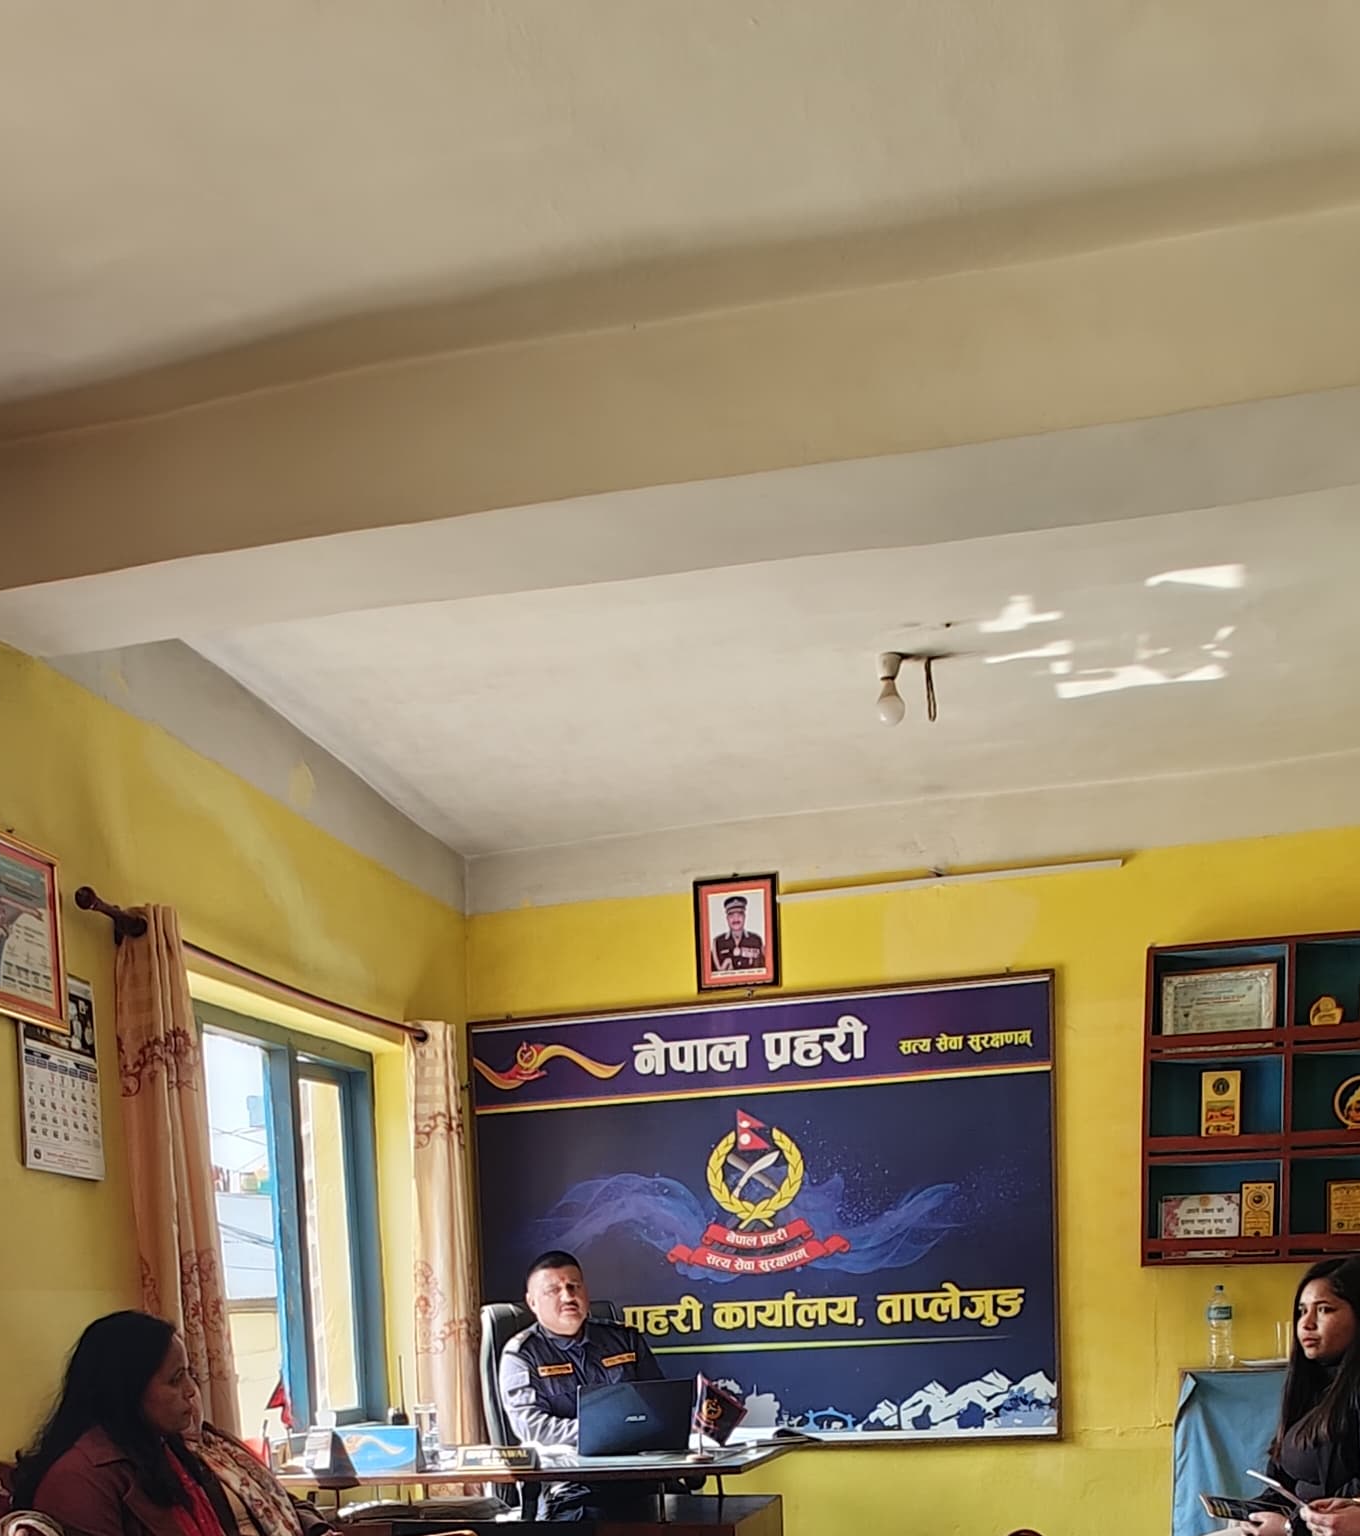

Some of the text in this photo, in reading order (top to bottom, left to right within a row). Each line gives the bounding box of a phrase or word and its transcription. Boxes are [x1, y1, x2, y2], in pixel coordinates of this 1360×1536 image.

[633, 1015, 868, 1075] नेपाल प्रहरी
[899, 1029, 1033, 1055] सत्य सेवा सुरक्षणम्
[725, 1228, 787, 1247] नेपाल प्रहरी
[705, 1252, 731, 1269] सत्य
[734, 1257, 755, 1271] सेवा
[713, 1292, 864, 1328] कार्यालय,
[876, 1283, 1025, 1327] ताप्लेजुङ
